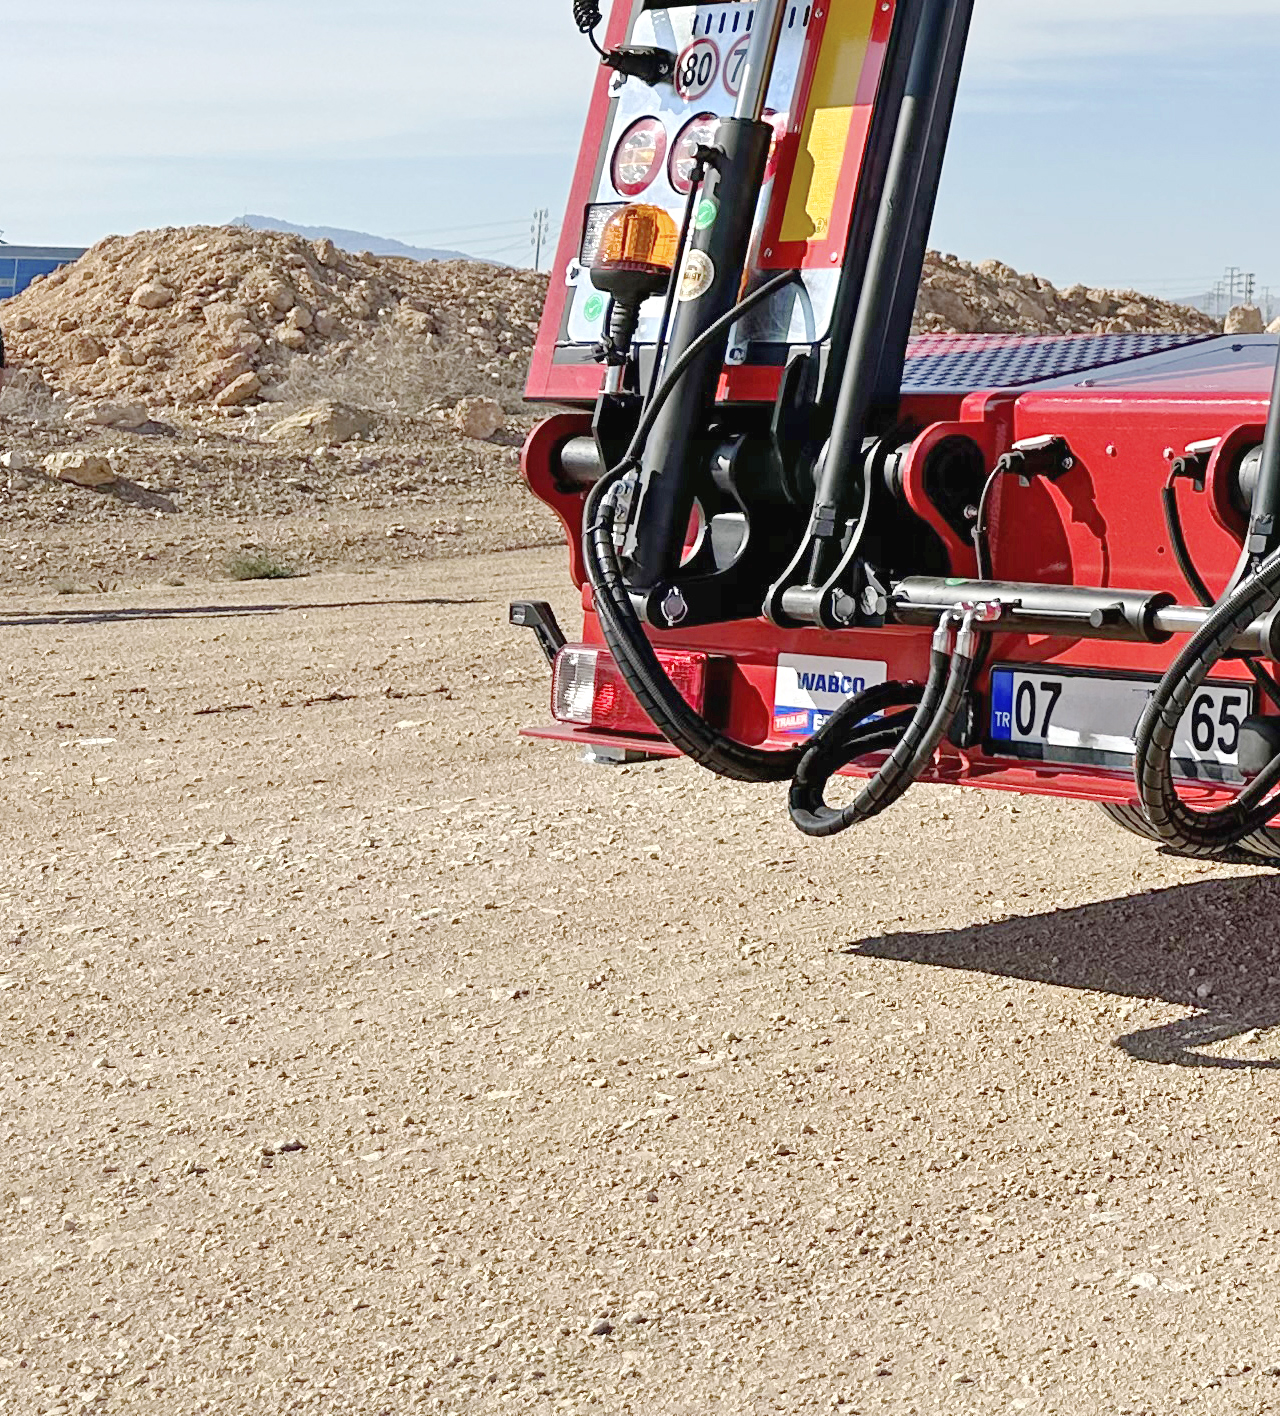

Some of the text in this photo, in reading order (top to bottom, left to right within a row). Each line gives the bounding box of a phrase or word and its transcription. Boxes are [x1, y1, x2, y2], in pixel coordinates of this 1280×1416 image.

[682, 52, 713, 87] 80
[730, 48, 748, 83] 7
[797, 672, 865, 694] WABCO
[775, 714, 808, 729] TRAILER
[994, 680, 1242, 755] TR 07 65
